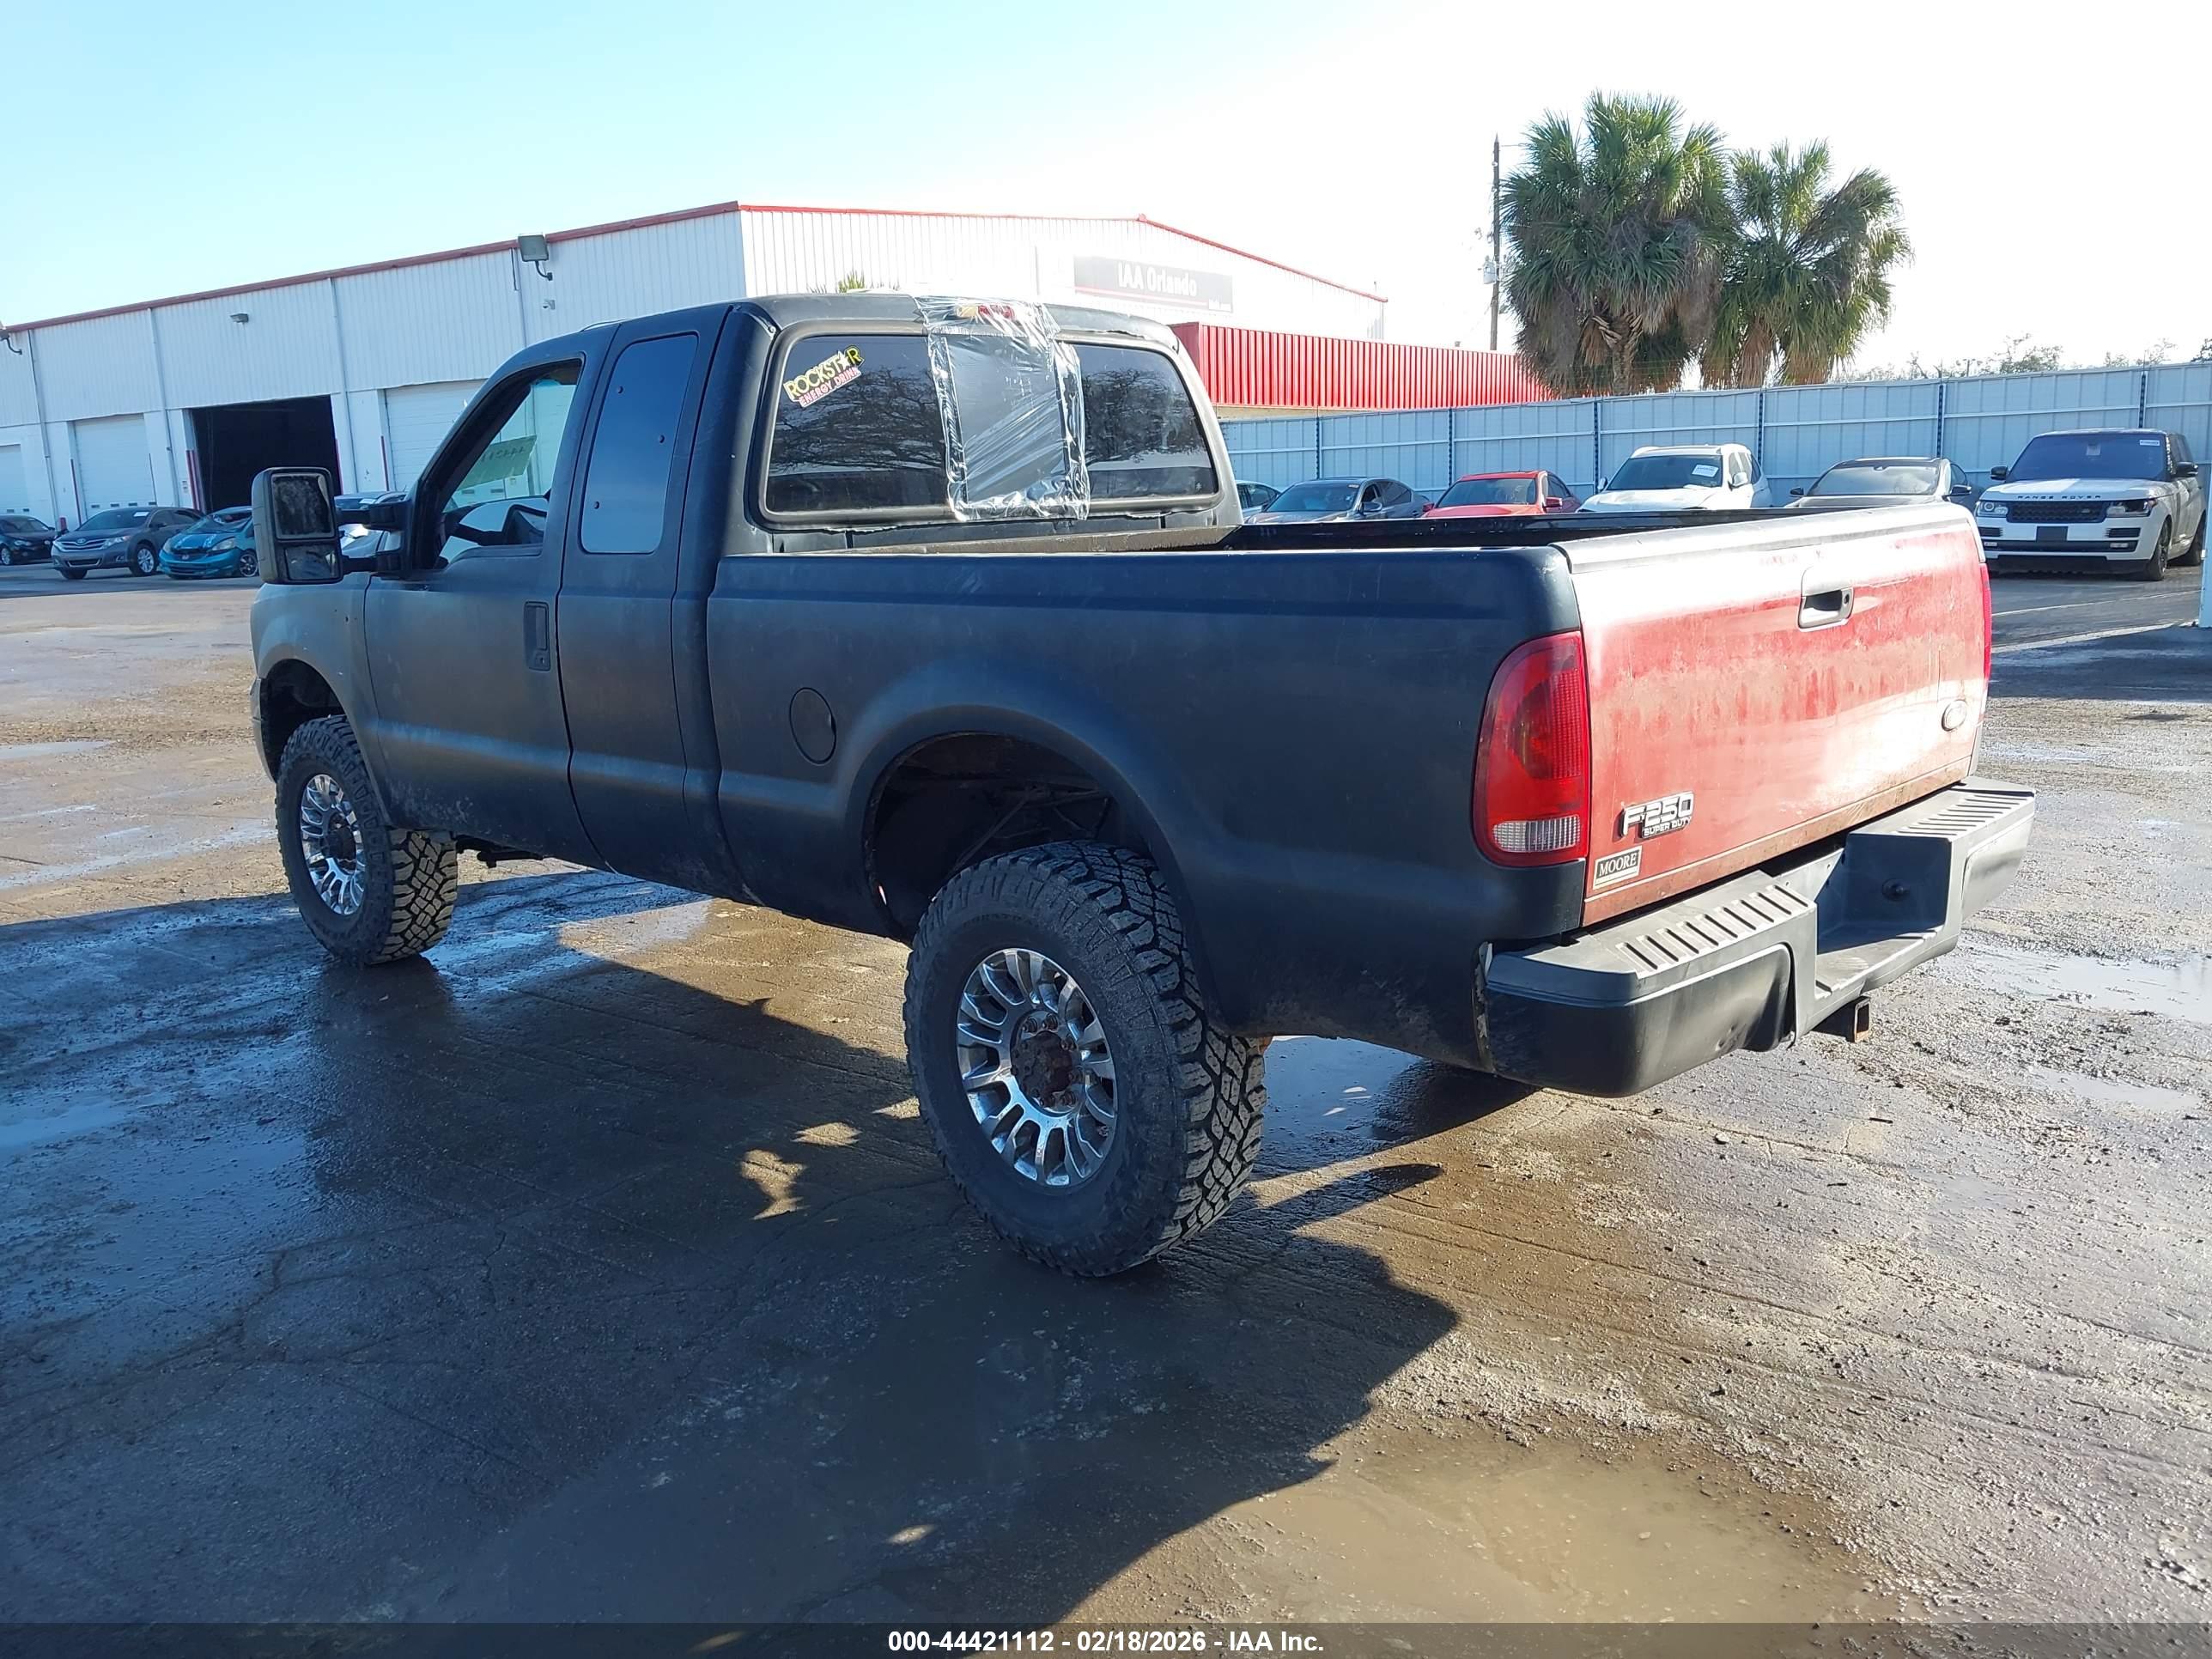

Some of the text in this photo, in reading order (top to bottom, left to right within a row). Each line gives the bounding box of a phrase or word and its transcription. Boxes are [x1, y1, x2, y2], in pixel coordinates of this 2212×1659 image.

[1117, 262, 1198, 297] IAA Orlando
[799, 380, 834, 405] ENERGY
[1644, 816, 1692, 836] SUPER DUTY
[1598, 852, 1638, 877] MOORE
